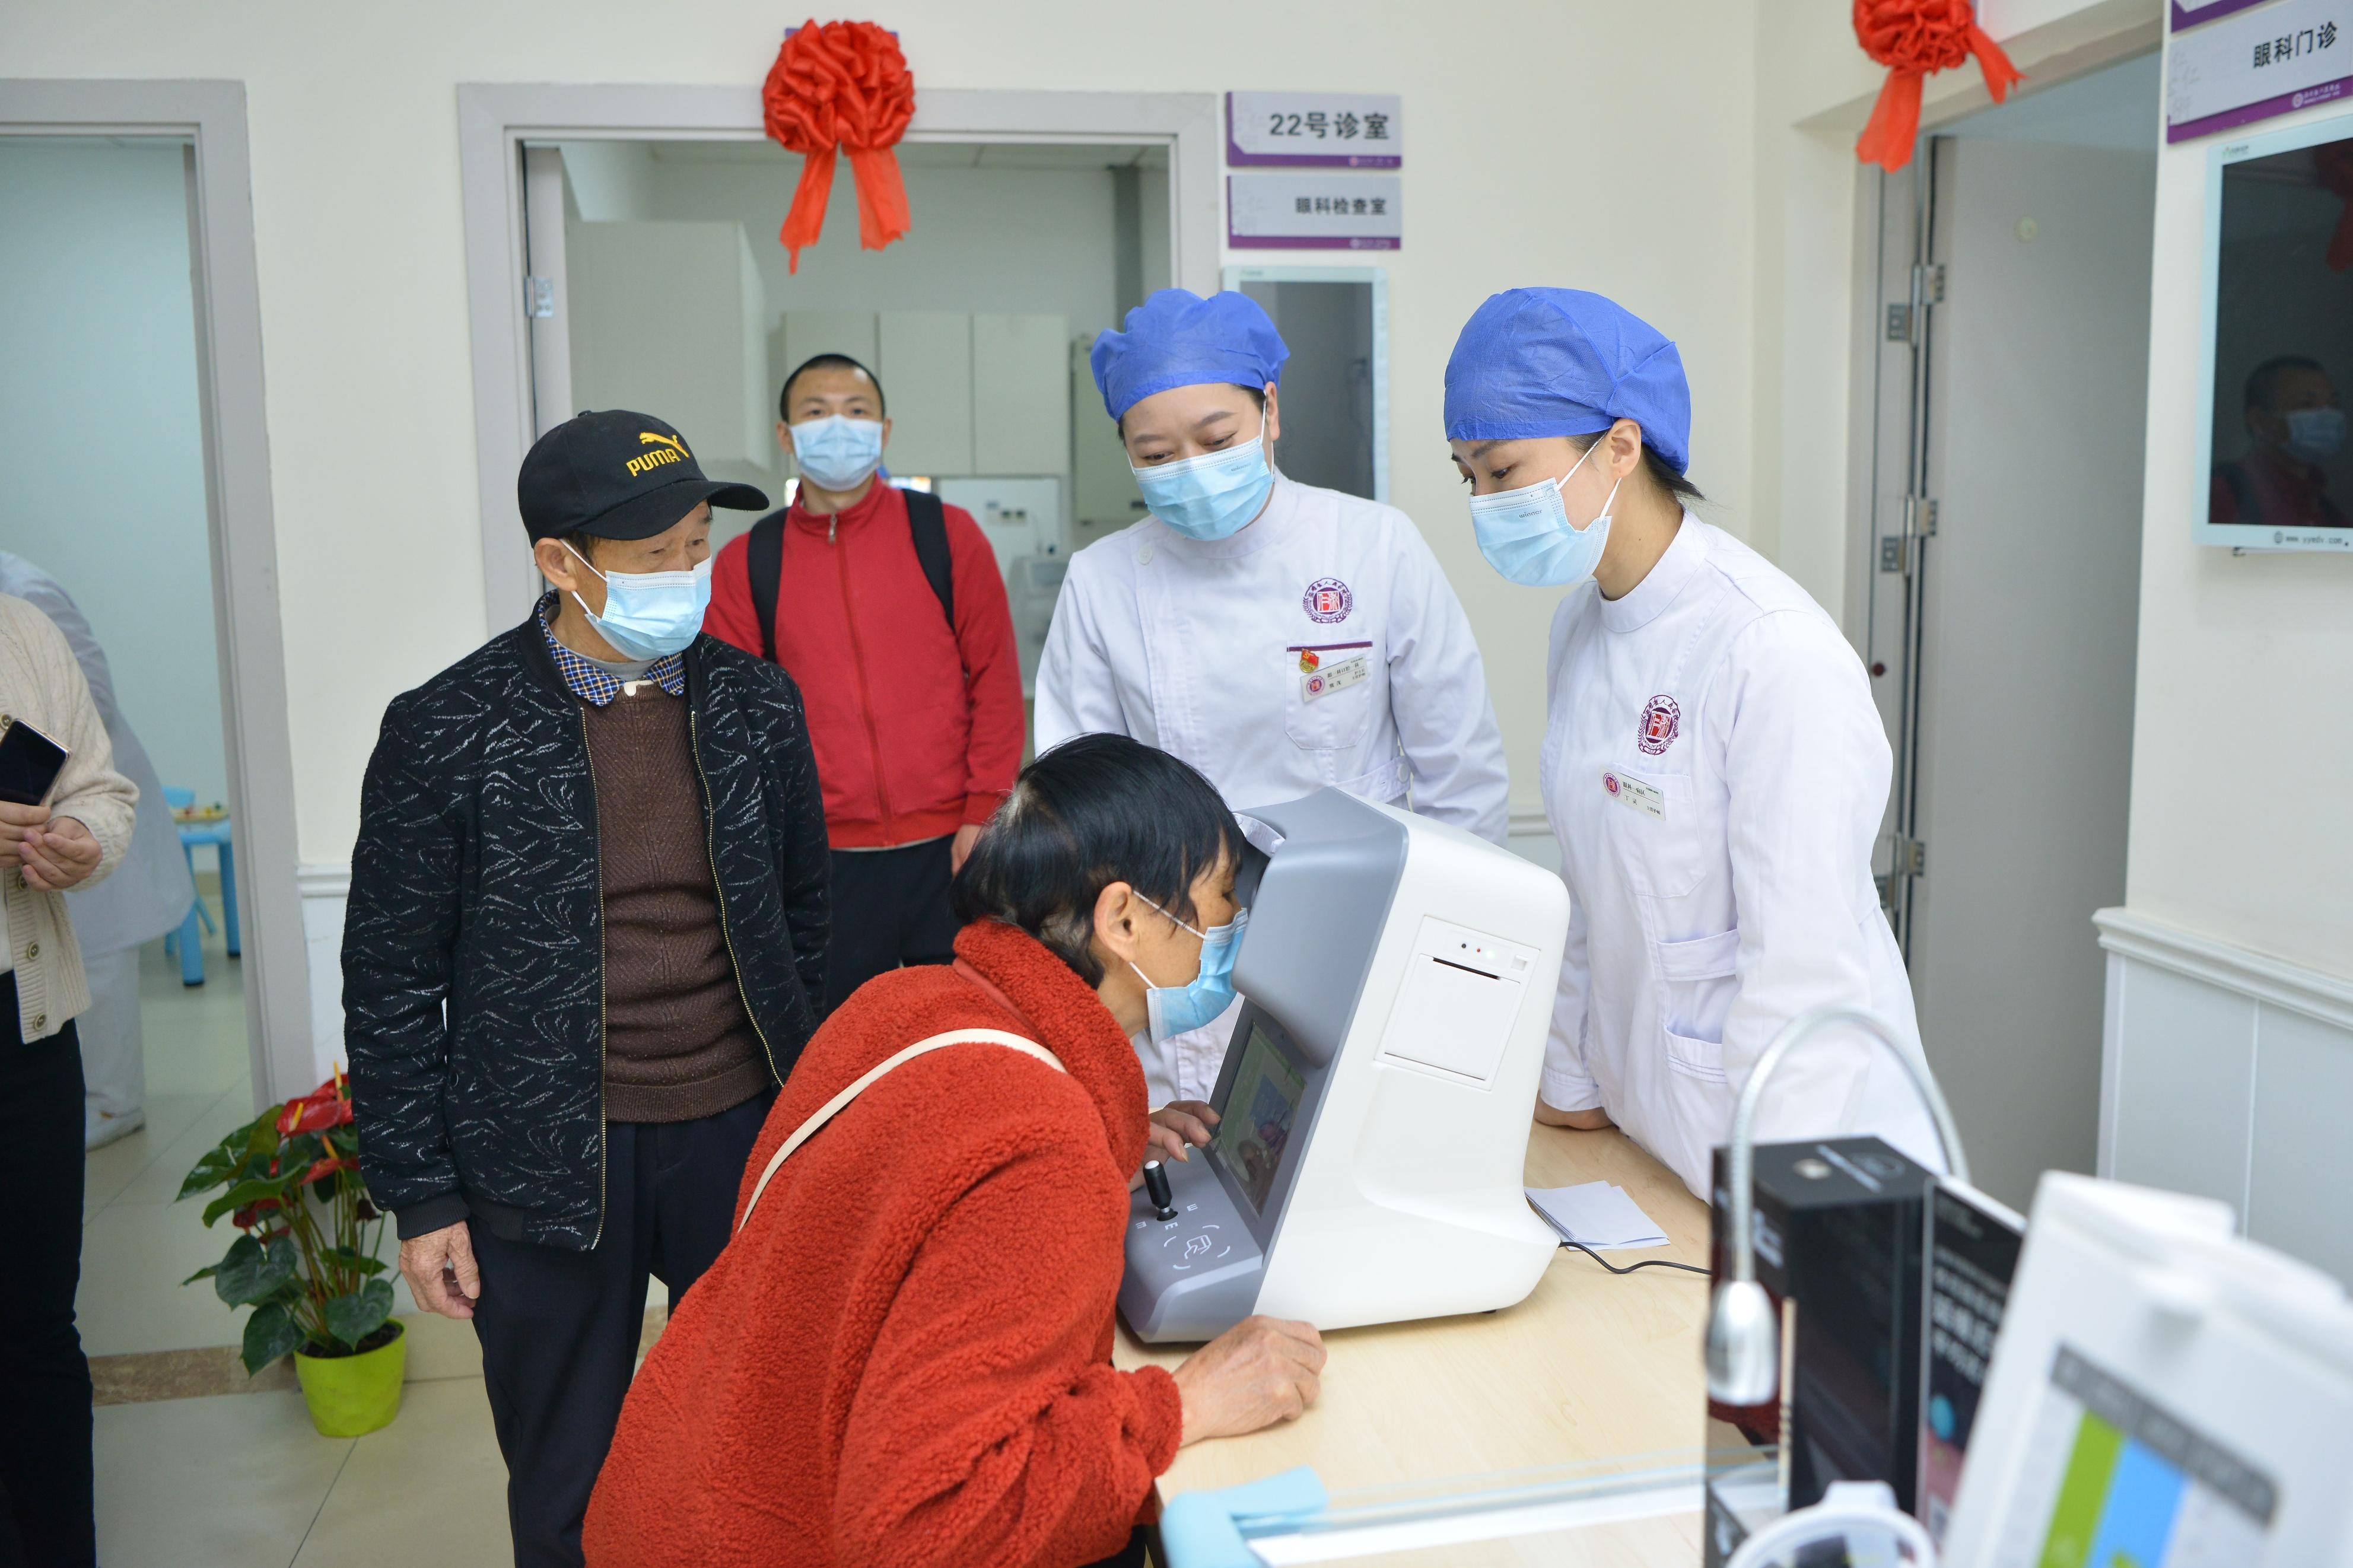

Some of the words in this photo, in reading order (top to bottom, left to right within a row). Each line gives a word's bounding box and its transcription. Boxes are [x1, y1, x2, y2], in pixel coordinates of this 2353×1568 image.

[2253, 21, 2338, 69] 眼科门诊
[1270, 112, 1389, 139] 22号诊室
[1295, 198, 1387, 215] 眼科检查室
[626, 449, 681, 477] PUMA
